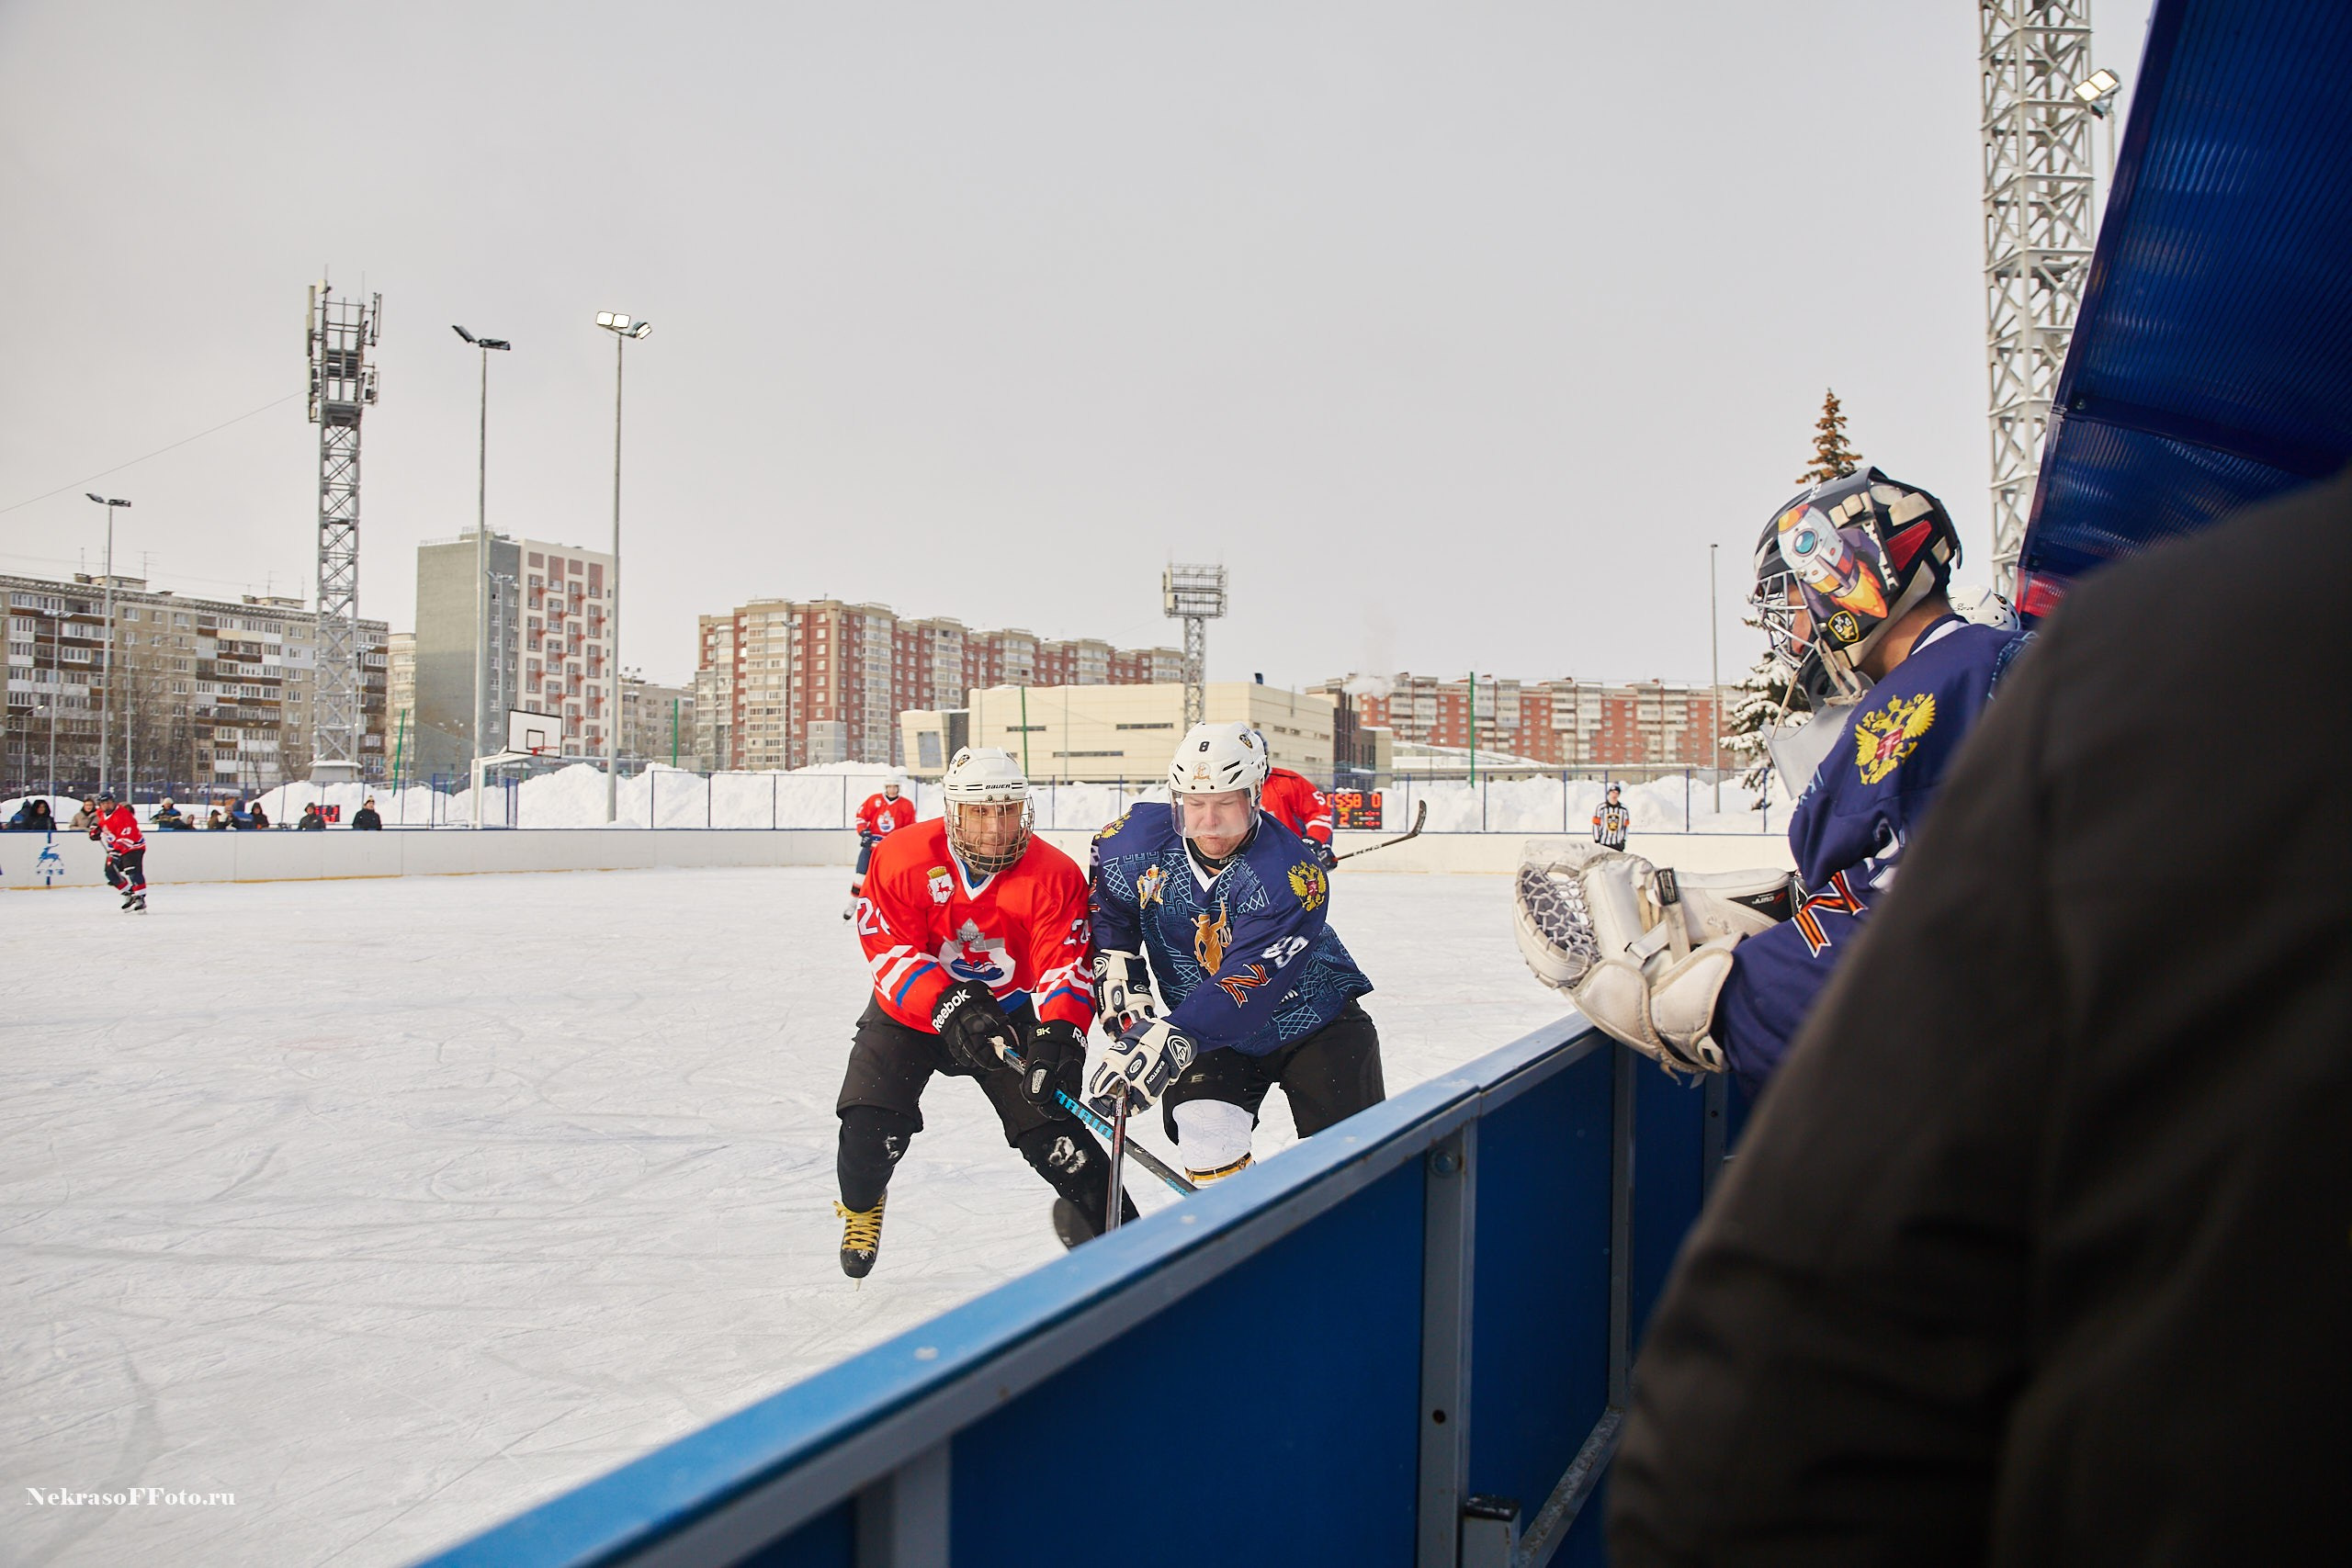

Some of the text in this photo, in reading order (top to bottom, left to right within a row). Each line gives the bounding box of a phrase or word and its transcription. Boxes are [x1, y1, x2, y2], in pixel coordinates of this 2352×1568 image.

[1198, 740, 1210, 752] 8
[932, 988, 972, 1032] Reebok
[1146, 1059, 1166, 1086] EASTON
[1055, 1089, 1115, 1143] ARRIO
